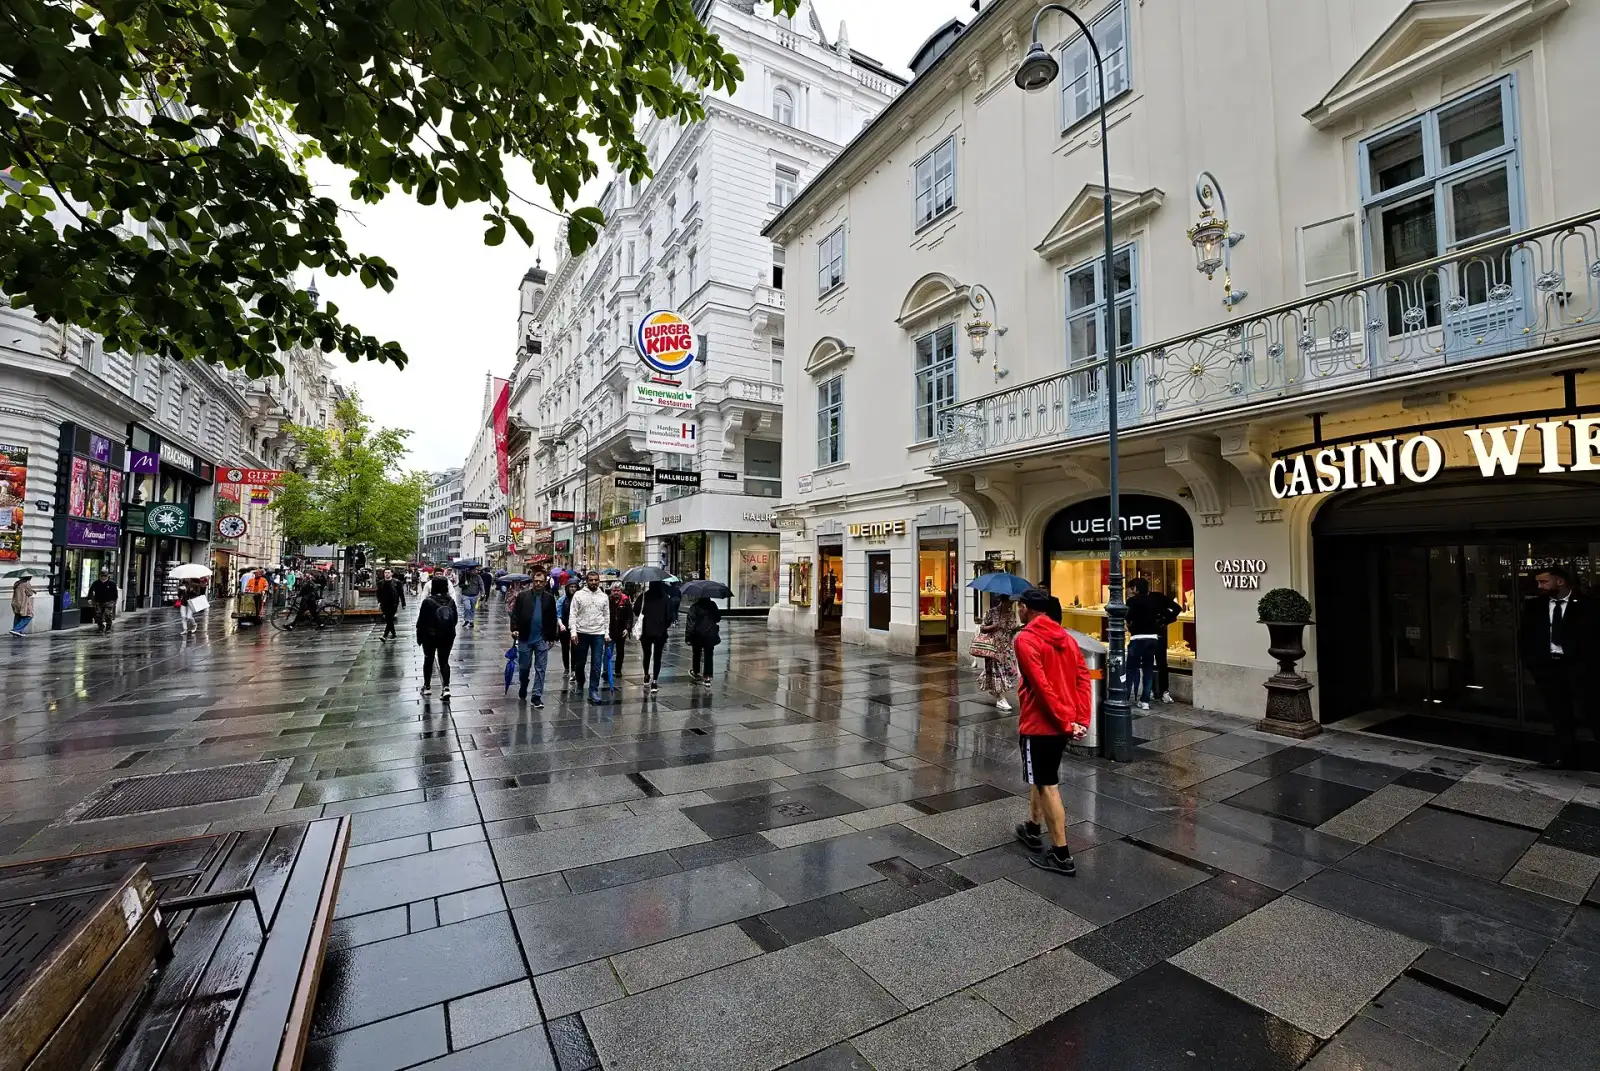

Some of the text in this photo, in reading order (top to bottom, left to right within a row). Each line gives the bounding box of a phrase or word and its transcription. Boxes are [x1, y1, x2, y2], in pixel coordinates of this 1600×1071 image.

[644, 323, 690, 339] BURGER
[646, 335, 692, 355] KING
[637, 386, 684, 400] Wienerwald
[658, 398, 692, 408] Restaurant
[618, 464, 651, 472] CALZEDONIA
[1269, 435, 1443, 499] CASINO
[659, 473, 698, 482] HALLHUBER
[160, 515, 186, 533] OUTLET
[743, 512, 774, 522] HALLH
[1070, 514, 1161, 533] WEMPE
[848, 520, 905, 537] WEMPE
[743, 554, 768, 564] SALE
[1214, 559, 1267, 573] CASINO
[1222, 575, 1259, 589] WIEN
